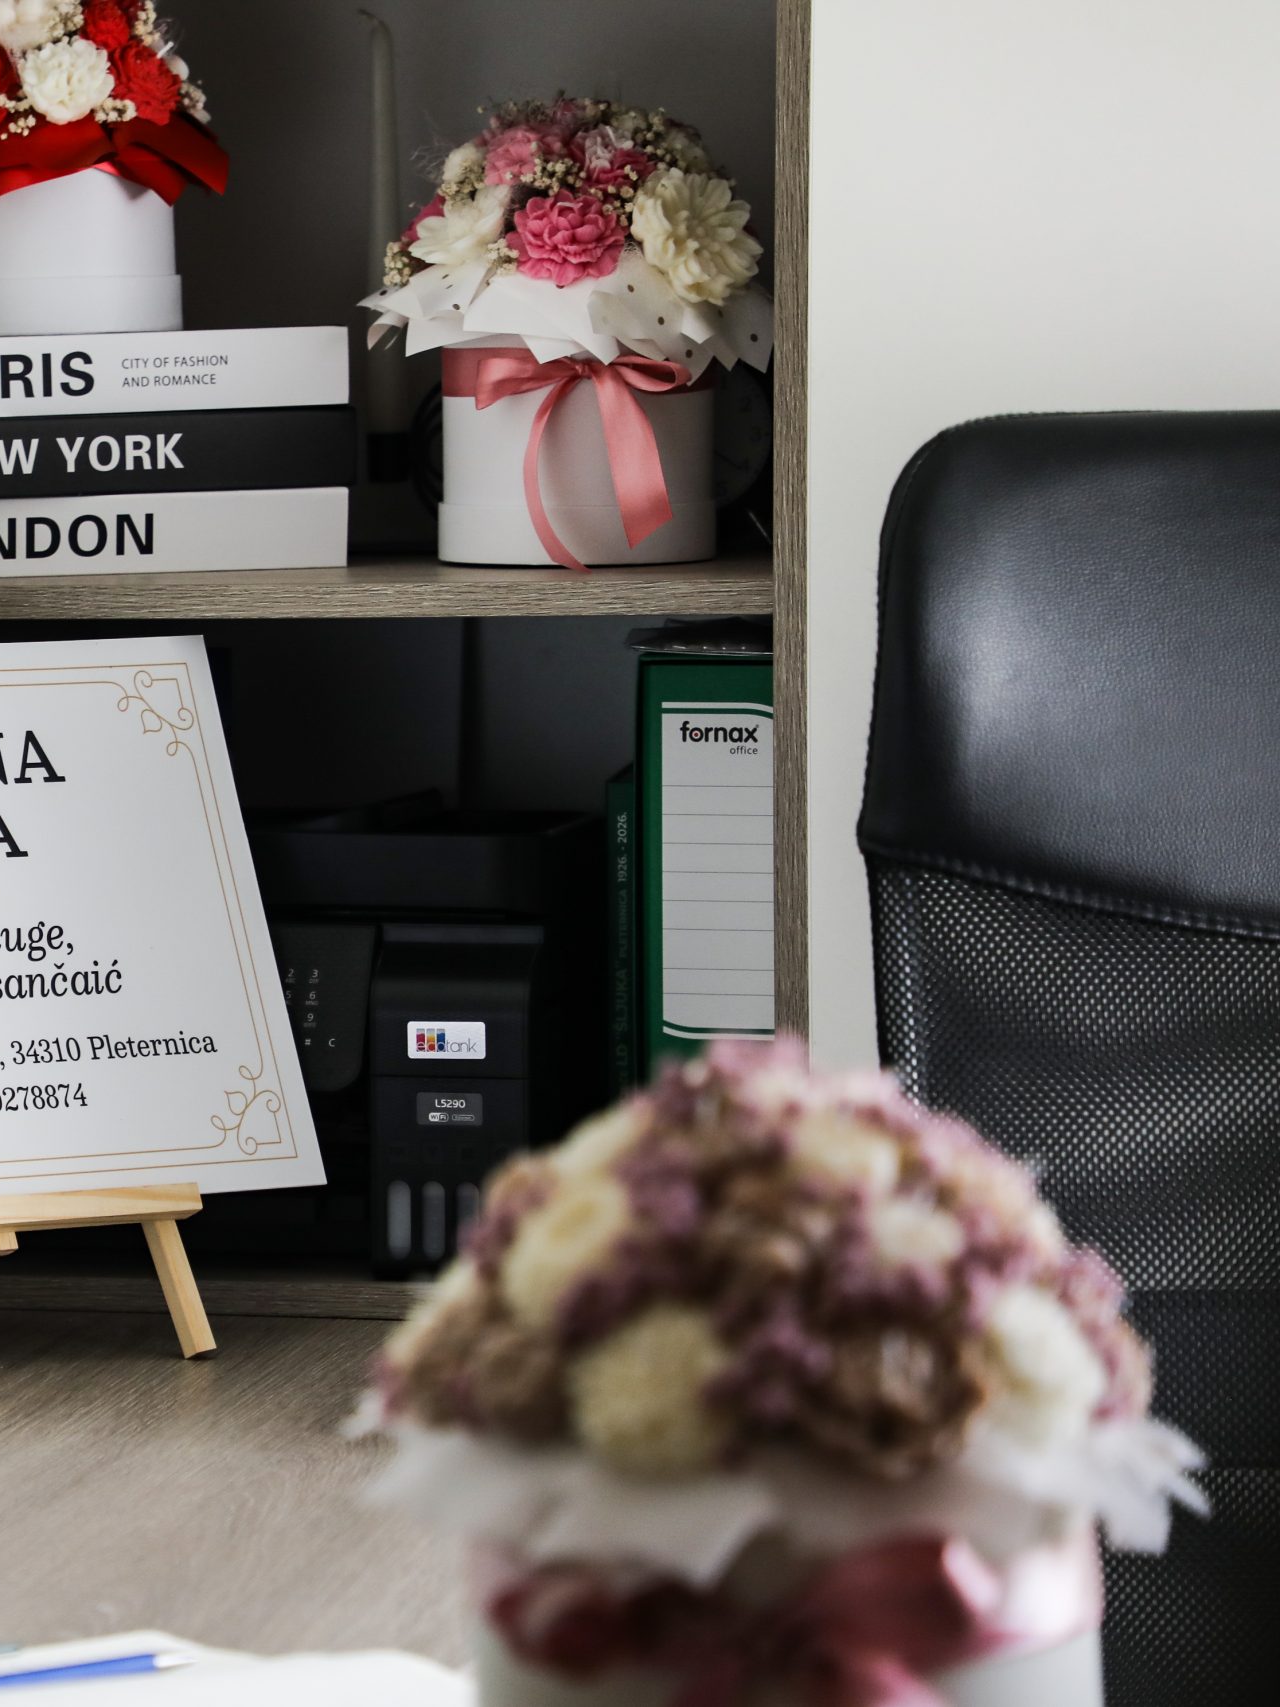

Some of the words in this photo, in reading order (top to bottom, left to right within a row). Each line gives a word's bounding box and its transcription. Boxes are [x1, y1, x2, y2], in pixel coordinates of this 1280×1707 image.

[121, 357, 149, 369] CITY
[153, 356, 170, 368] OF
[174, 354, 229, 367] FASHION
[122, 375, 150, 388] AND
[154, 373, 217, 387] ROMANCE
[55, 433, 185, 473] YORK
[680, 720, 759, 743] fornax
[729, 745, 758, 755] office
[616, 811, 628, 844] 2026.
[616, 853, 628, 883] 1926.
[10, 1036, 82, 1065] 34310
[86, 1030, 219, 1061] Pleternica
